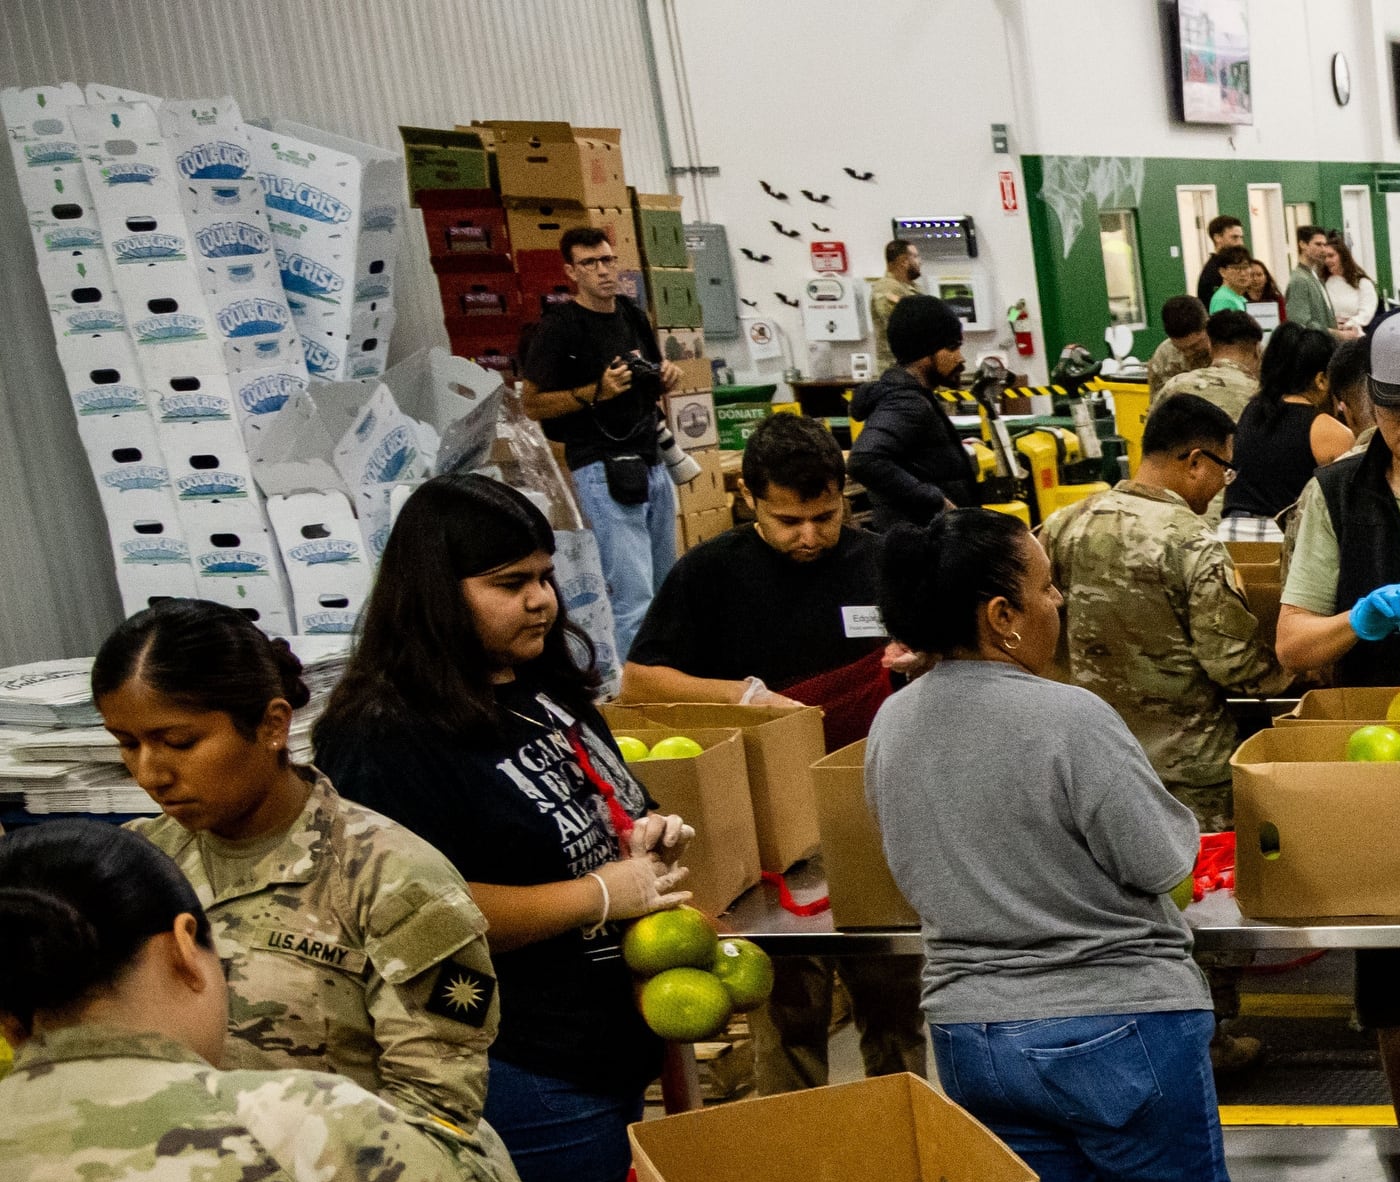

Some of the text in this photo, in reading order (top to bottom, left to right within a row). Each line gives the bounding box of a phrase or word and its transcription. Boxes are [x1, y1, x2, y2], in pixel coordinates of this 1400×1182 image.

[717, 408, 765, 420] DONATE
[518, 729, 577, 773] CAN
[296, 938, 349, 965] ARMY
